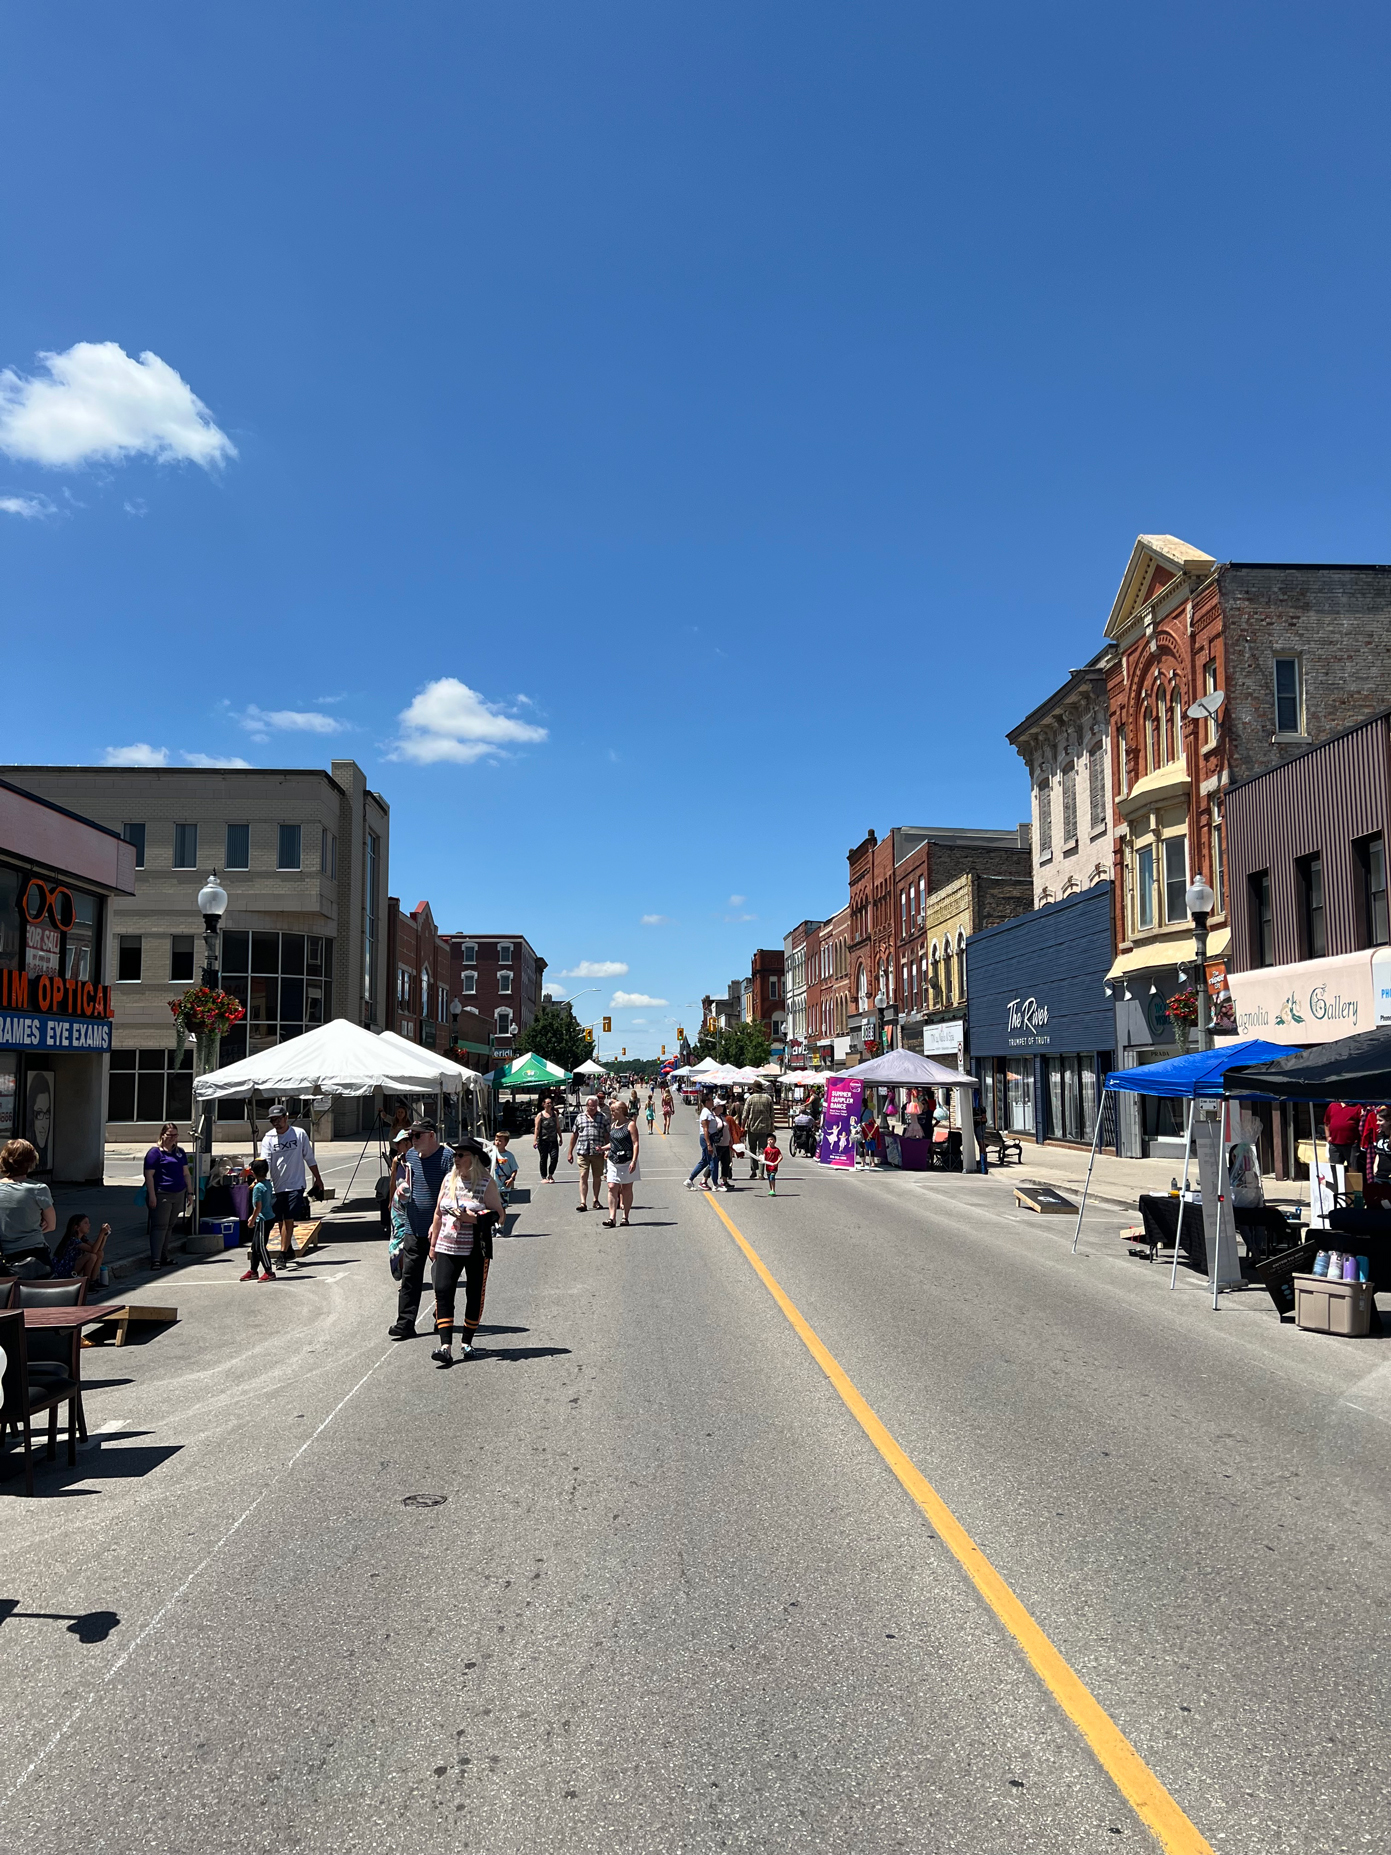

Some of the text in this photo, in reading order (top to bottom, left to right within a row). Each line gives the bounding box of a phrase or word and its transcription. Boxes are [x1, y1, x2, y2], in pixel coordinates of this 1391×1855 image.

[38, 975, 115, 1019] OPTICAL
[1309, 983, 1358, 1027] Gallery
[1007, 997, 1049, 1035] The River
[46, 1021, 70, 1047] EYE
[72, 1023, 109, 1049] EXAMS
[1008, 1036, 1050, 1047] TRUMPET OF TRUTH
[831, 1090, 852, 1098] SUMMER
[831, 1096, 854, 1104] SAMPLER
[830, 1102, 847, 1110] DANCE
